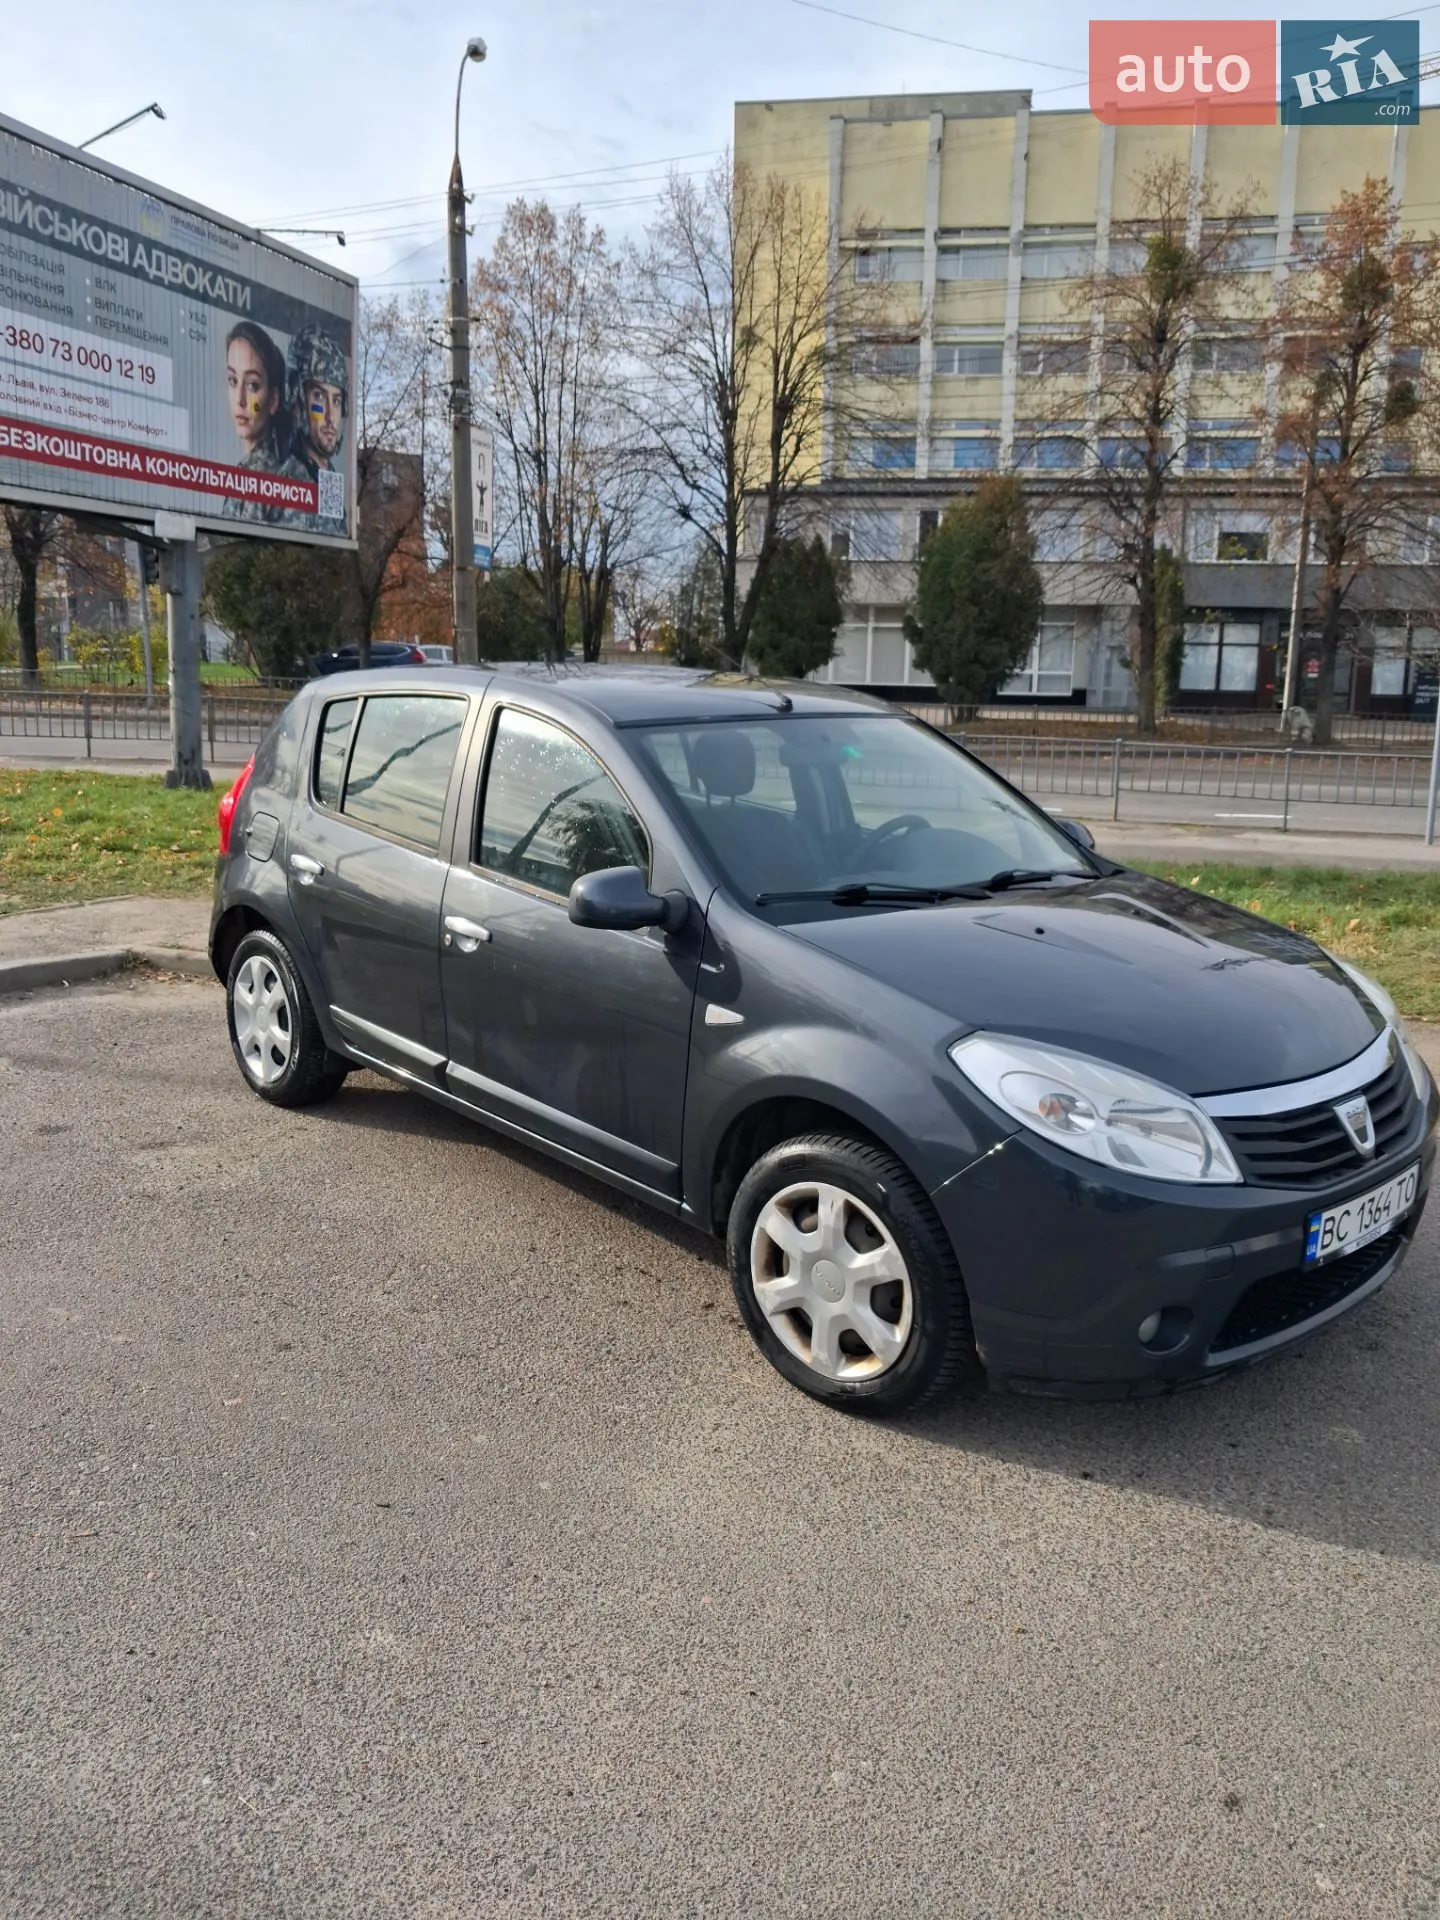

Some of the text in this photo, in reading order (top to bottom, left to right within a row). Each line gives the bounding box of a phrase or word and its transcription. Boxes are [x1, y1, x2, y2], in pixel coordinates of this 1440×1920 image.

[95, 277, 117, 294] ВЛК
[132, 243, 251, 311] АДВОКАТИ
[94, 297, 144, 323] ВИПЛАТИ
[95, 315, 169, 346] ПЕРЕМІЩЕННЯ
[49, 337, 73, 362] 73
[77, 346, 112, 373] 000
[116, 358, 134, 379] 12
[138, 364, 156, 384] 19
[95, 397, 110, 409] 186
[0, 426, 314, 505] БЕЗКОШТОВНА КОНСУЛЬТАЦІЯ ЮРИСТА
[1321, 1210, 1350, 1250] BC
[1357, 1186, 1393, 1233] 1364
[1397, 1172, 1415, 1210] TO
